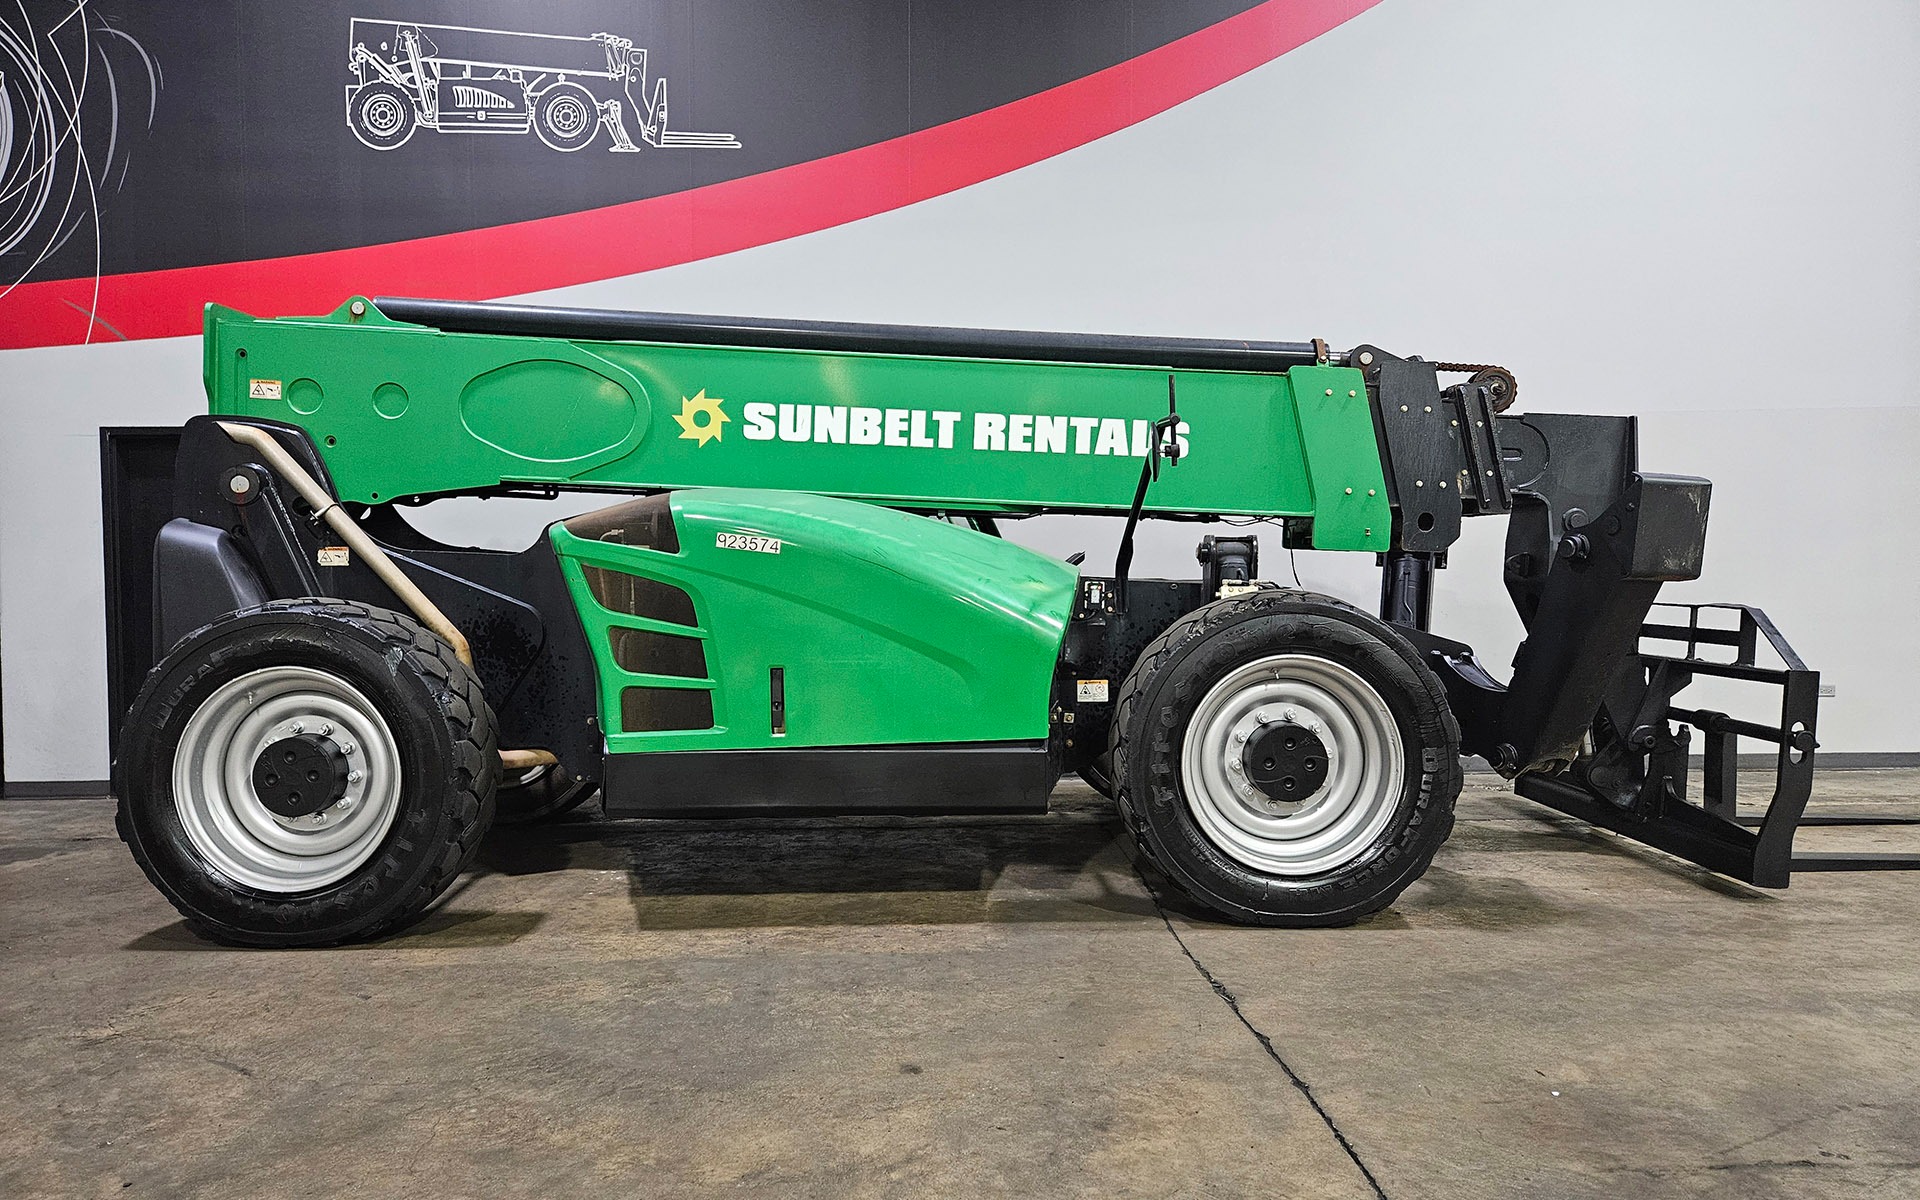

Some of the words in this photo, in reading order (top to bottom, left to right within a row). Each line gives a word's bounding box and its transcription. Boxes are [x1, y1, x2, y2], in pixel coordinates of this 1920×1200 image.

[743, 402, 962, 449] SUNBELT
[973, 411, 1190, 459] RENTALS
[717, 533, 779, 553] 923574
